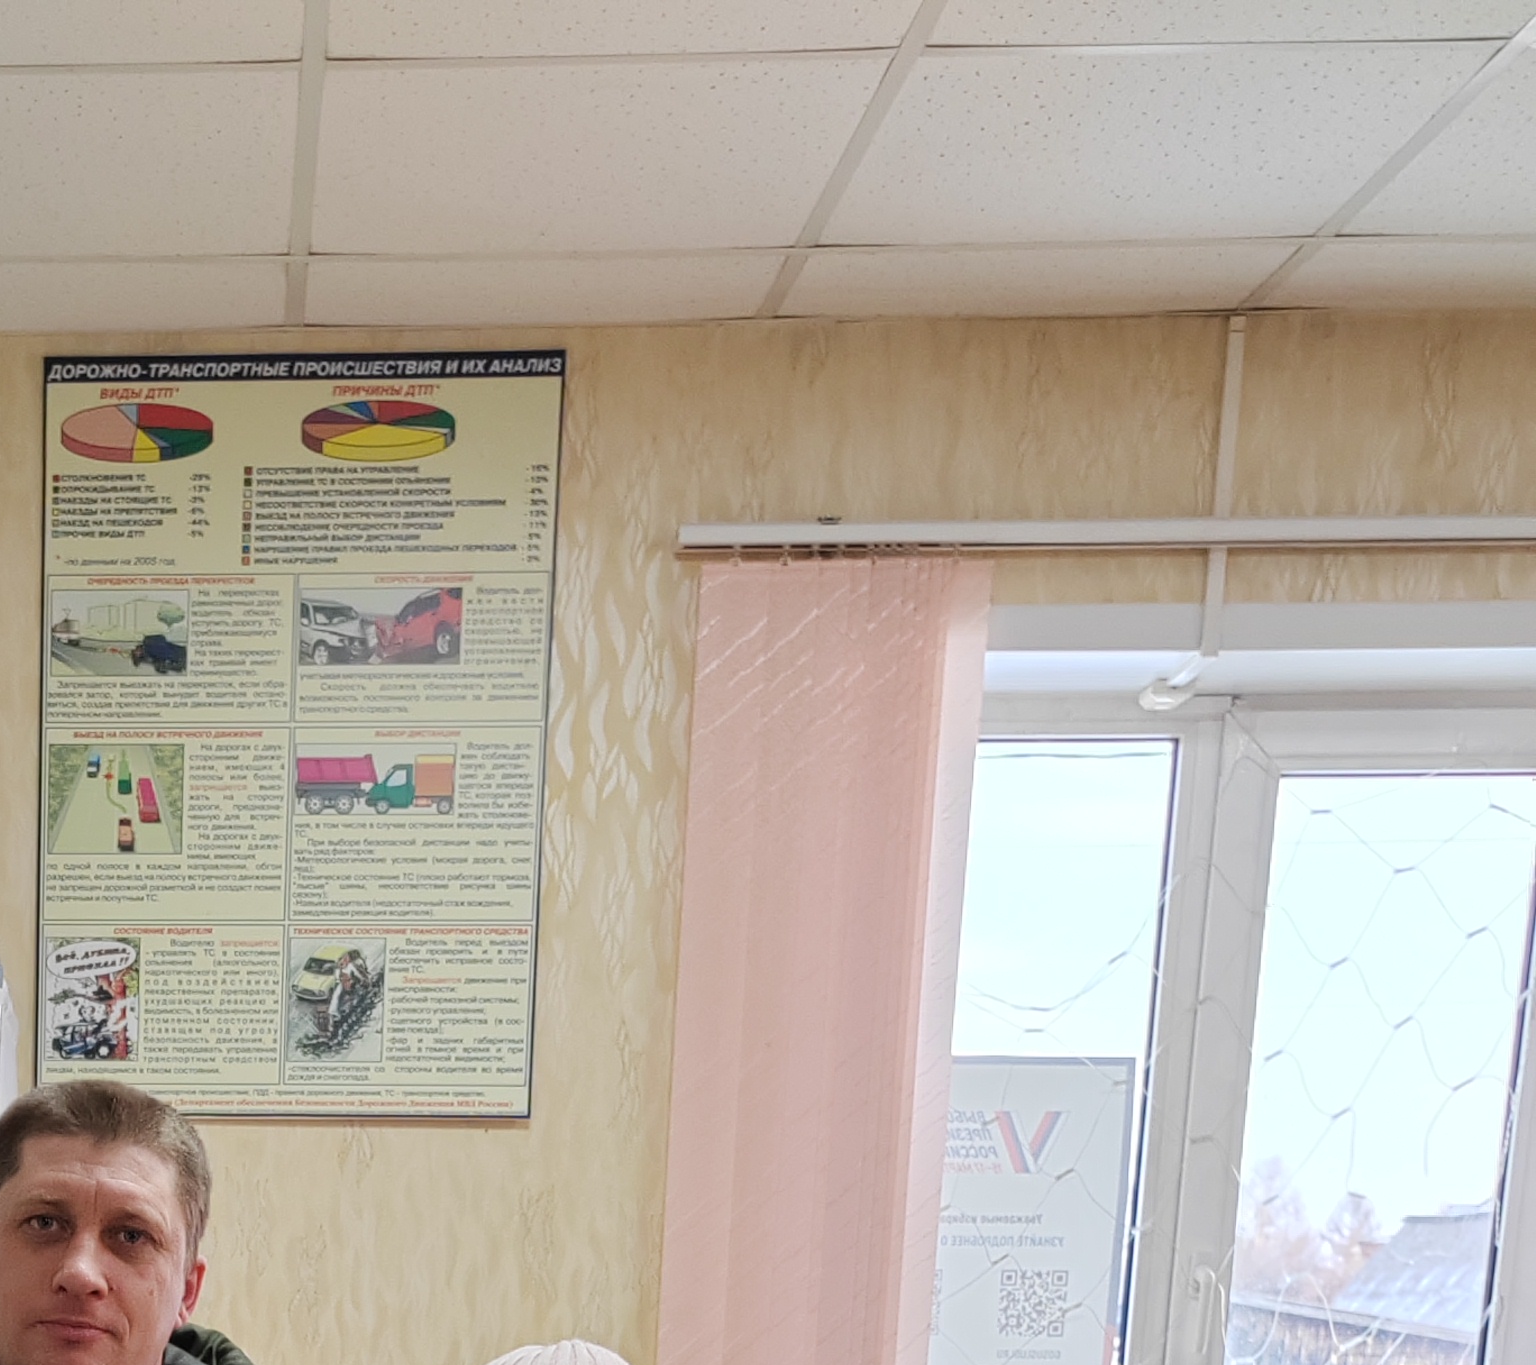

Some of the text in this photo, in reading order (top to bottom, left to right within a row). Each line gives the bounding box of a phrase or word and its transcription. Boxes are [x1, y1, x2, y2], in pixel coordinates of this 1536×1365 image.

[48, 357, 562, 381] ДОРОЖНО-ТРАНСПОРТНЫЕ ПРОИСШЕСТВИЯ И ИХ АНАЛИЗ
[100, 388, 142, 401] ВИДЫ
[332, 384, 402, 397] ПРИЧИНЫ
[167, 927, 213, 935] ВОДИТЕЛЯ
